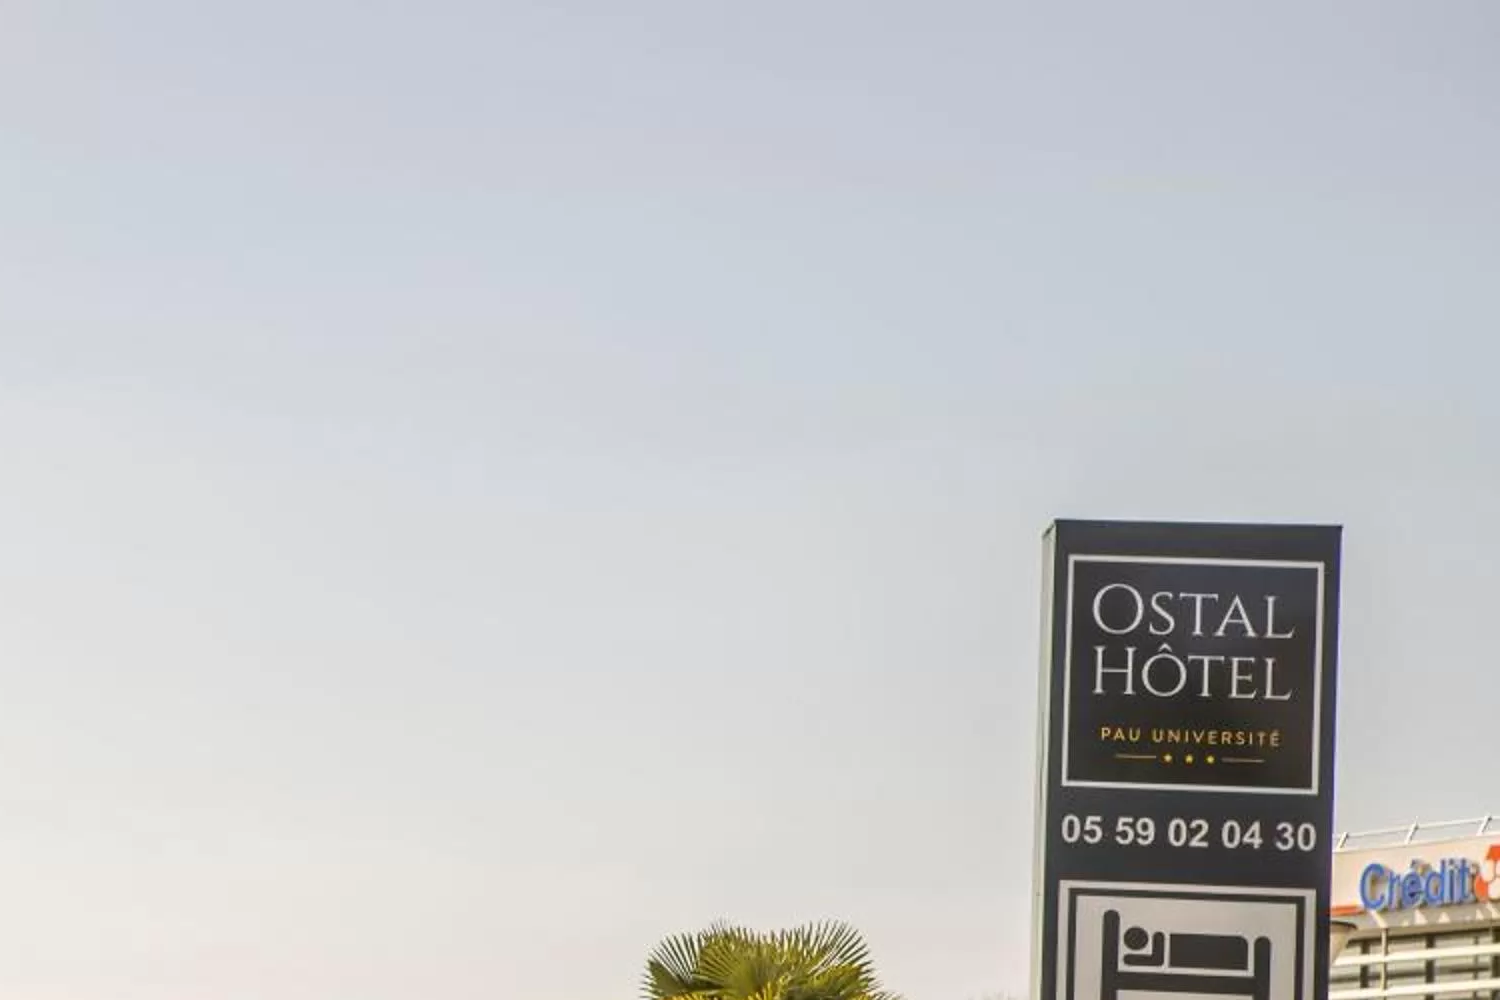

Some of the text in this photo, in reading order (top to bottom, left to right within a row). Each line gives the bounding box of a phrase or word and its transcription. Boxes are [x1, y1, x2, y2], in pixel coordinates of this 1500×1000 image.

[1092, 642, 1294, 701] HÔTEL
[1101, 727, 1282, 747] PAU UNIVERSITÉ
[1061, 814, 1317, 851] 05 59 02 04 30
[1360, 858, 1472, 910] Crédit
